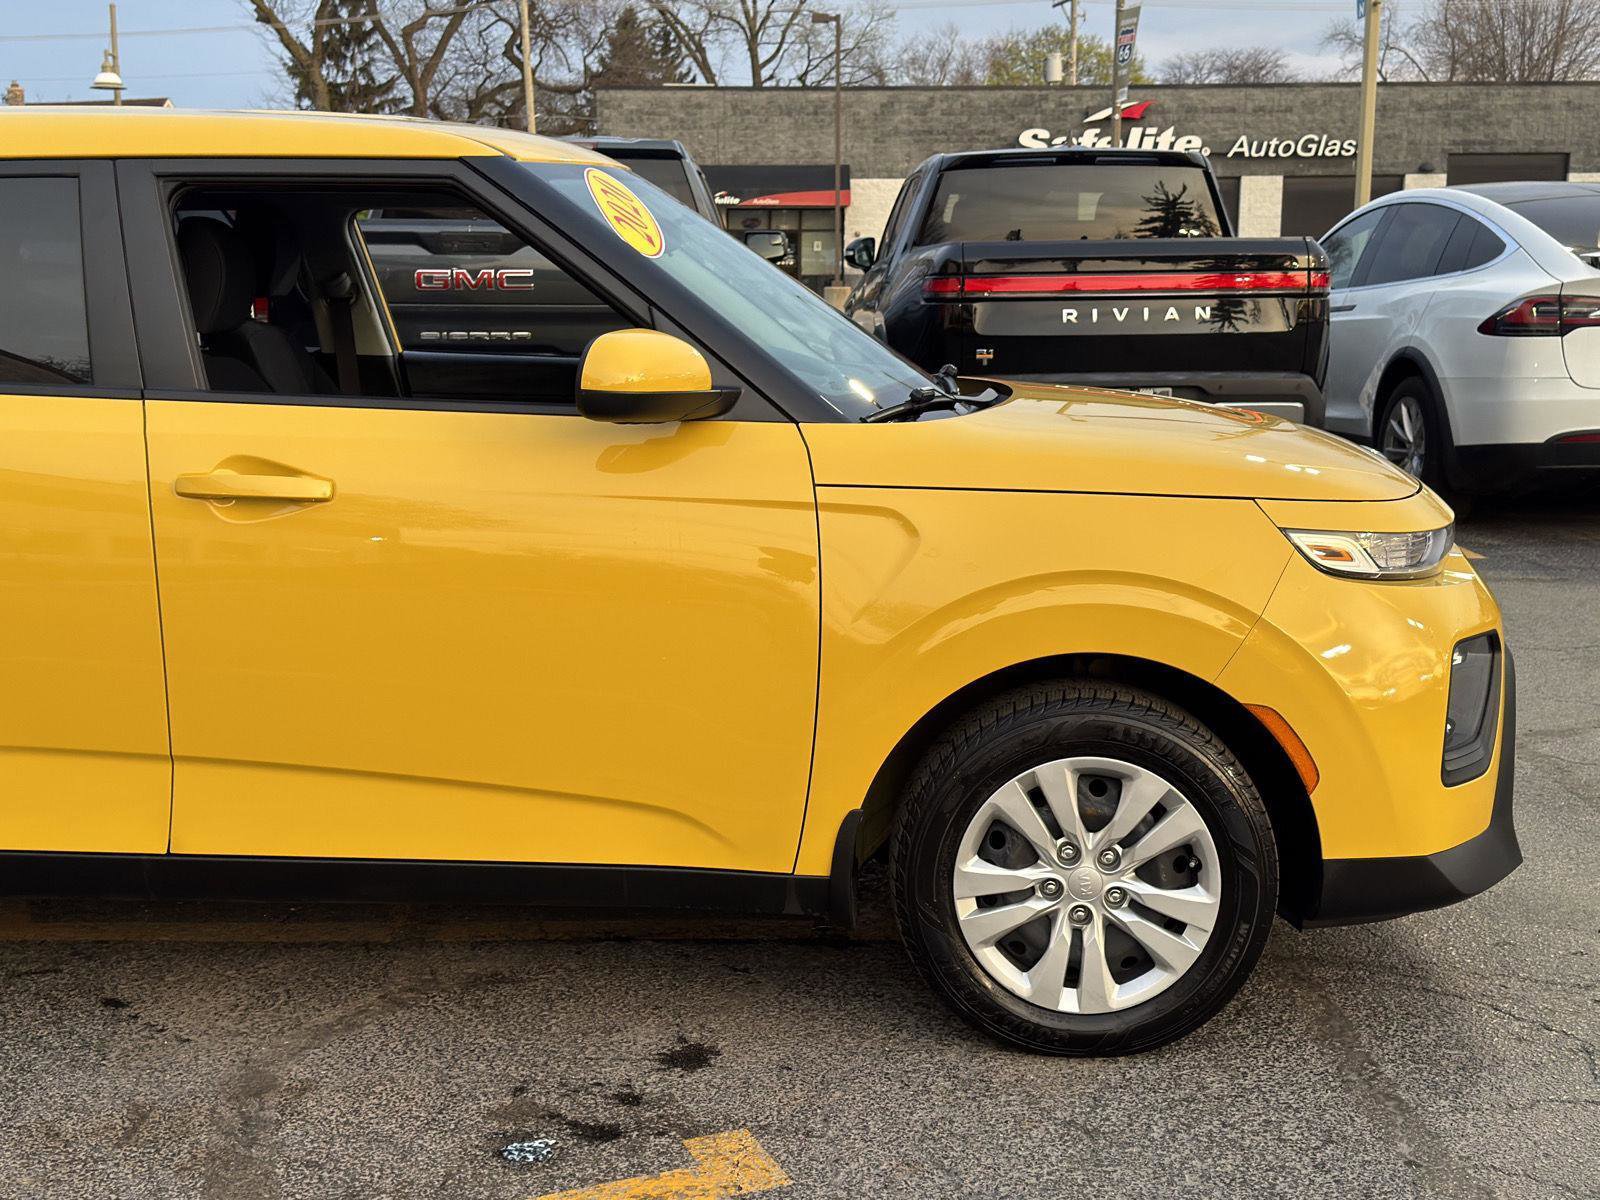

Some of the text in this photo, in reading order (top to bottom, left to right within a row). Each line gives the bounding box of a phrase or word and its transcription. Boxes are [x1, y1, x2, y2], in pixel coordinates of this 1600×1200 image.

[1118, 44, 1132, 61] 66
[1227, 134, 1358, 157] AutoGlas
[414, 268, 535, 291] GMC
[1062, 306, 1211, 323] RIVIAN
[420, 331, 533, 341] SIERRA
